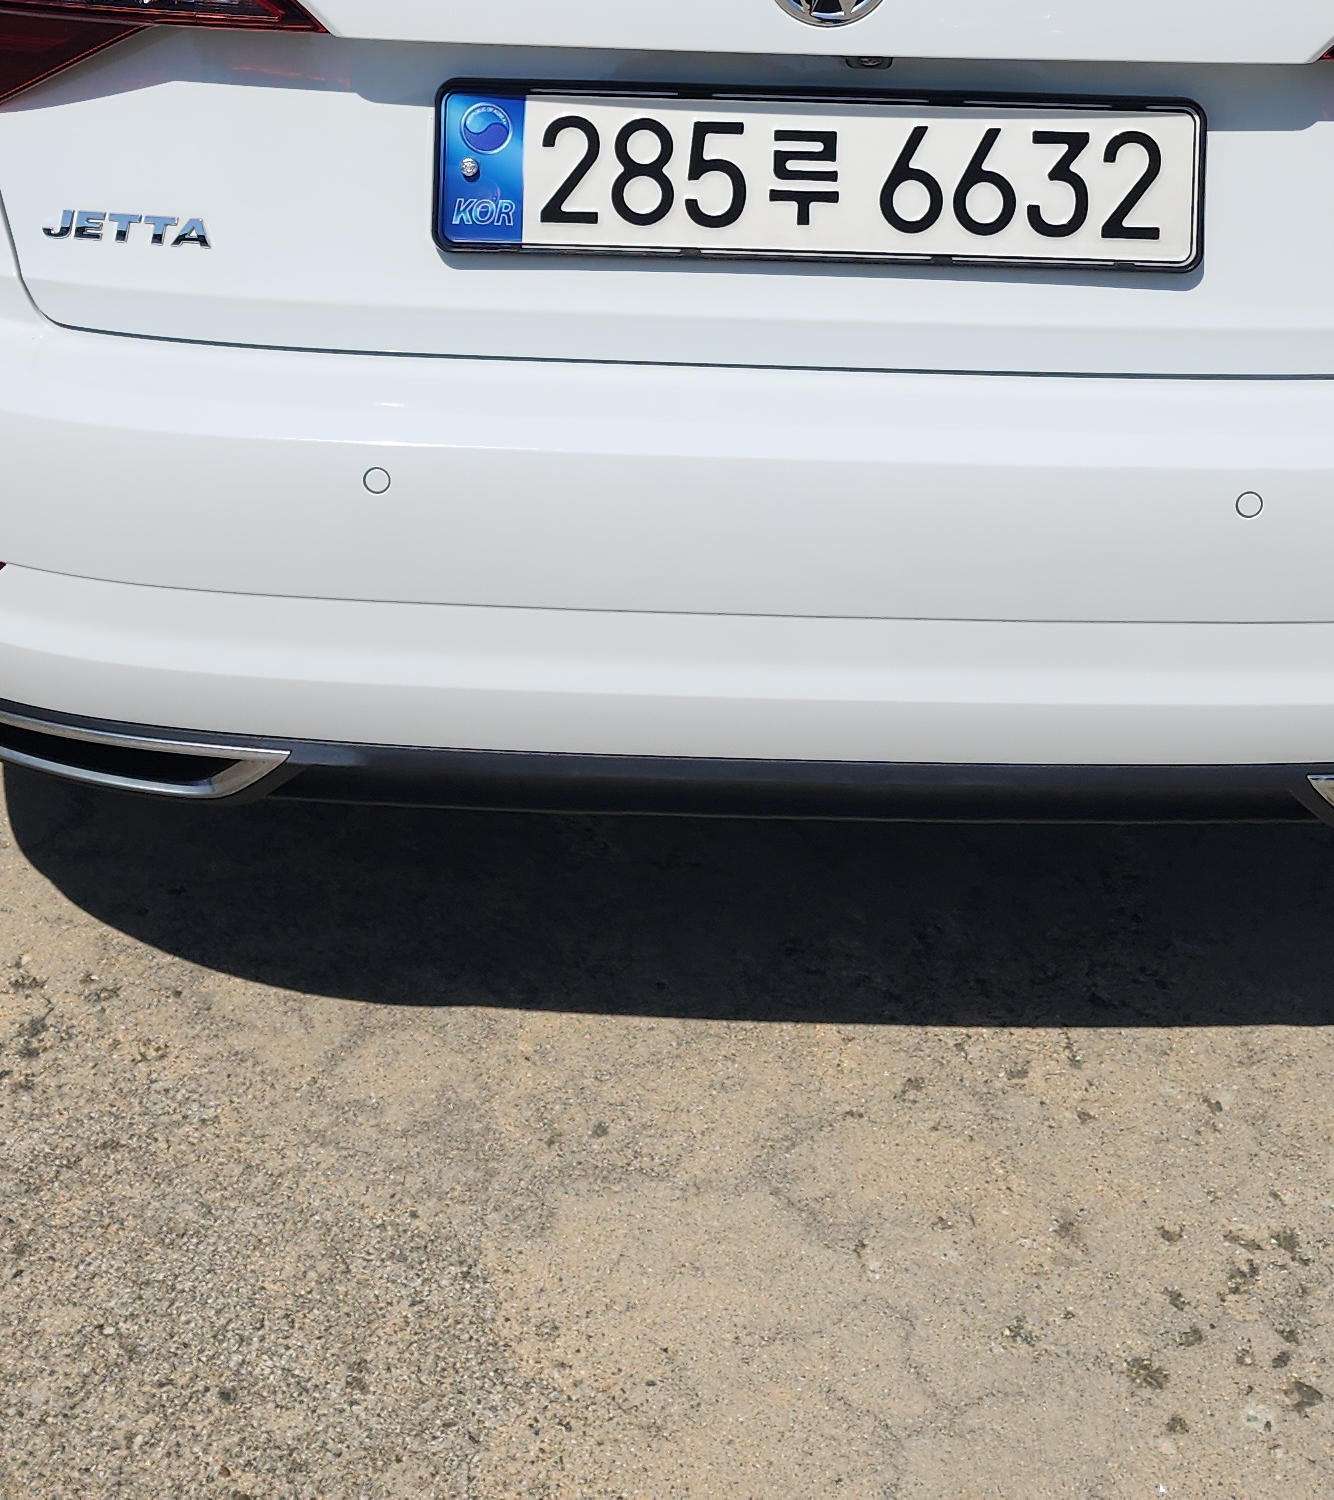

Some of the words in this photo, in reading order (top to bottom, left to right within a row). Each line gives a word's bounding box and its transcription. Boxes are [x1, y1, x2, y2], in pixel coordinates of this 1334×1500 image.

[539, 114, 841, 229] 285루
[879, 124, 1162, 241] 6632
[42, 208, 212, 250] JETTA
[452, 197, 516, 227] KOR
